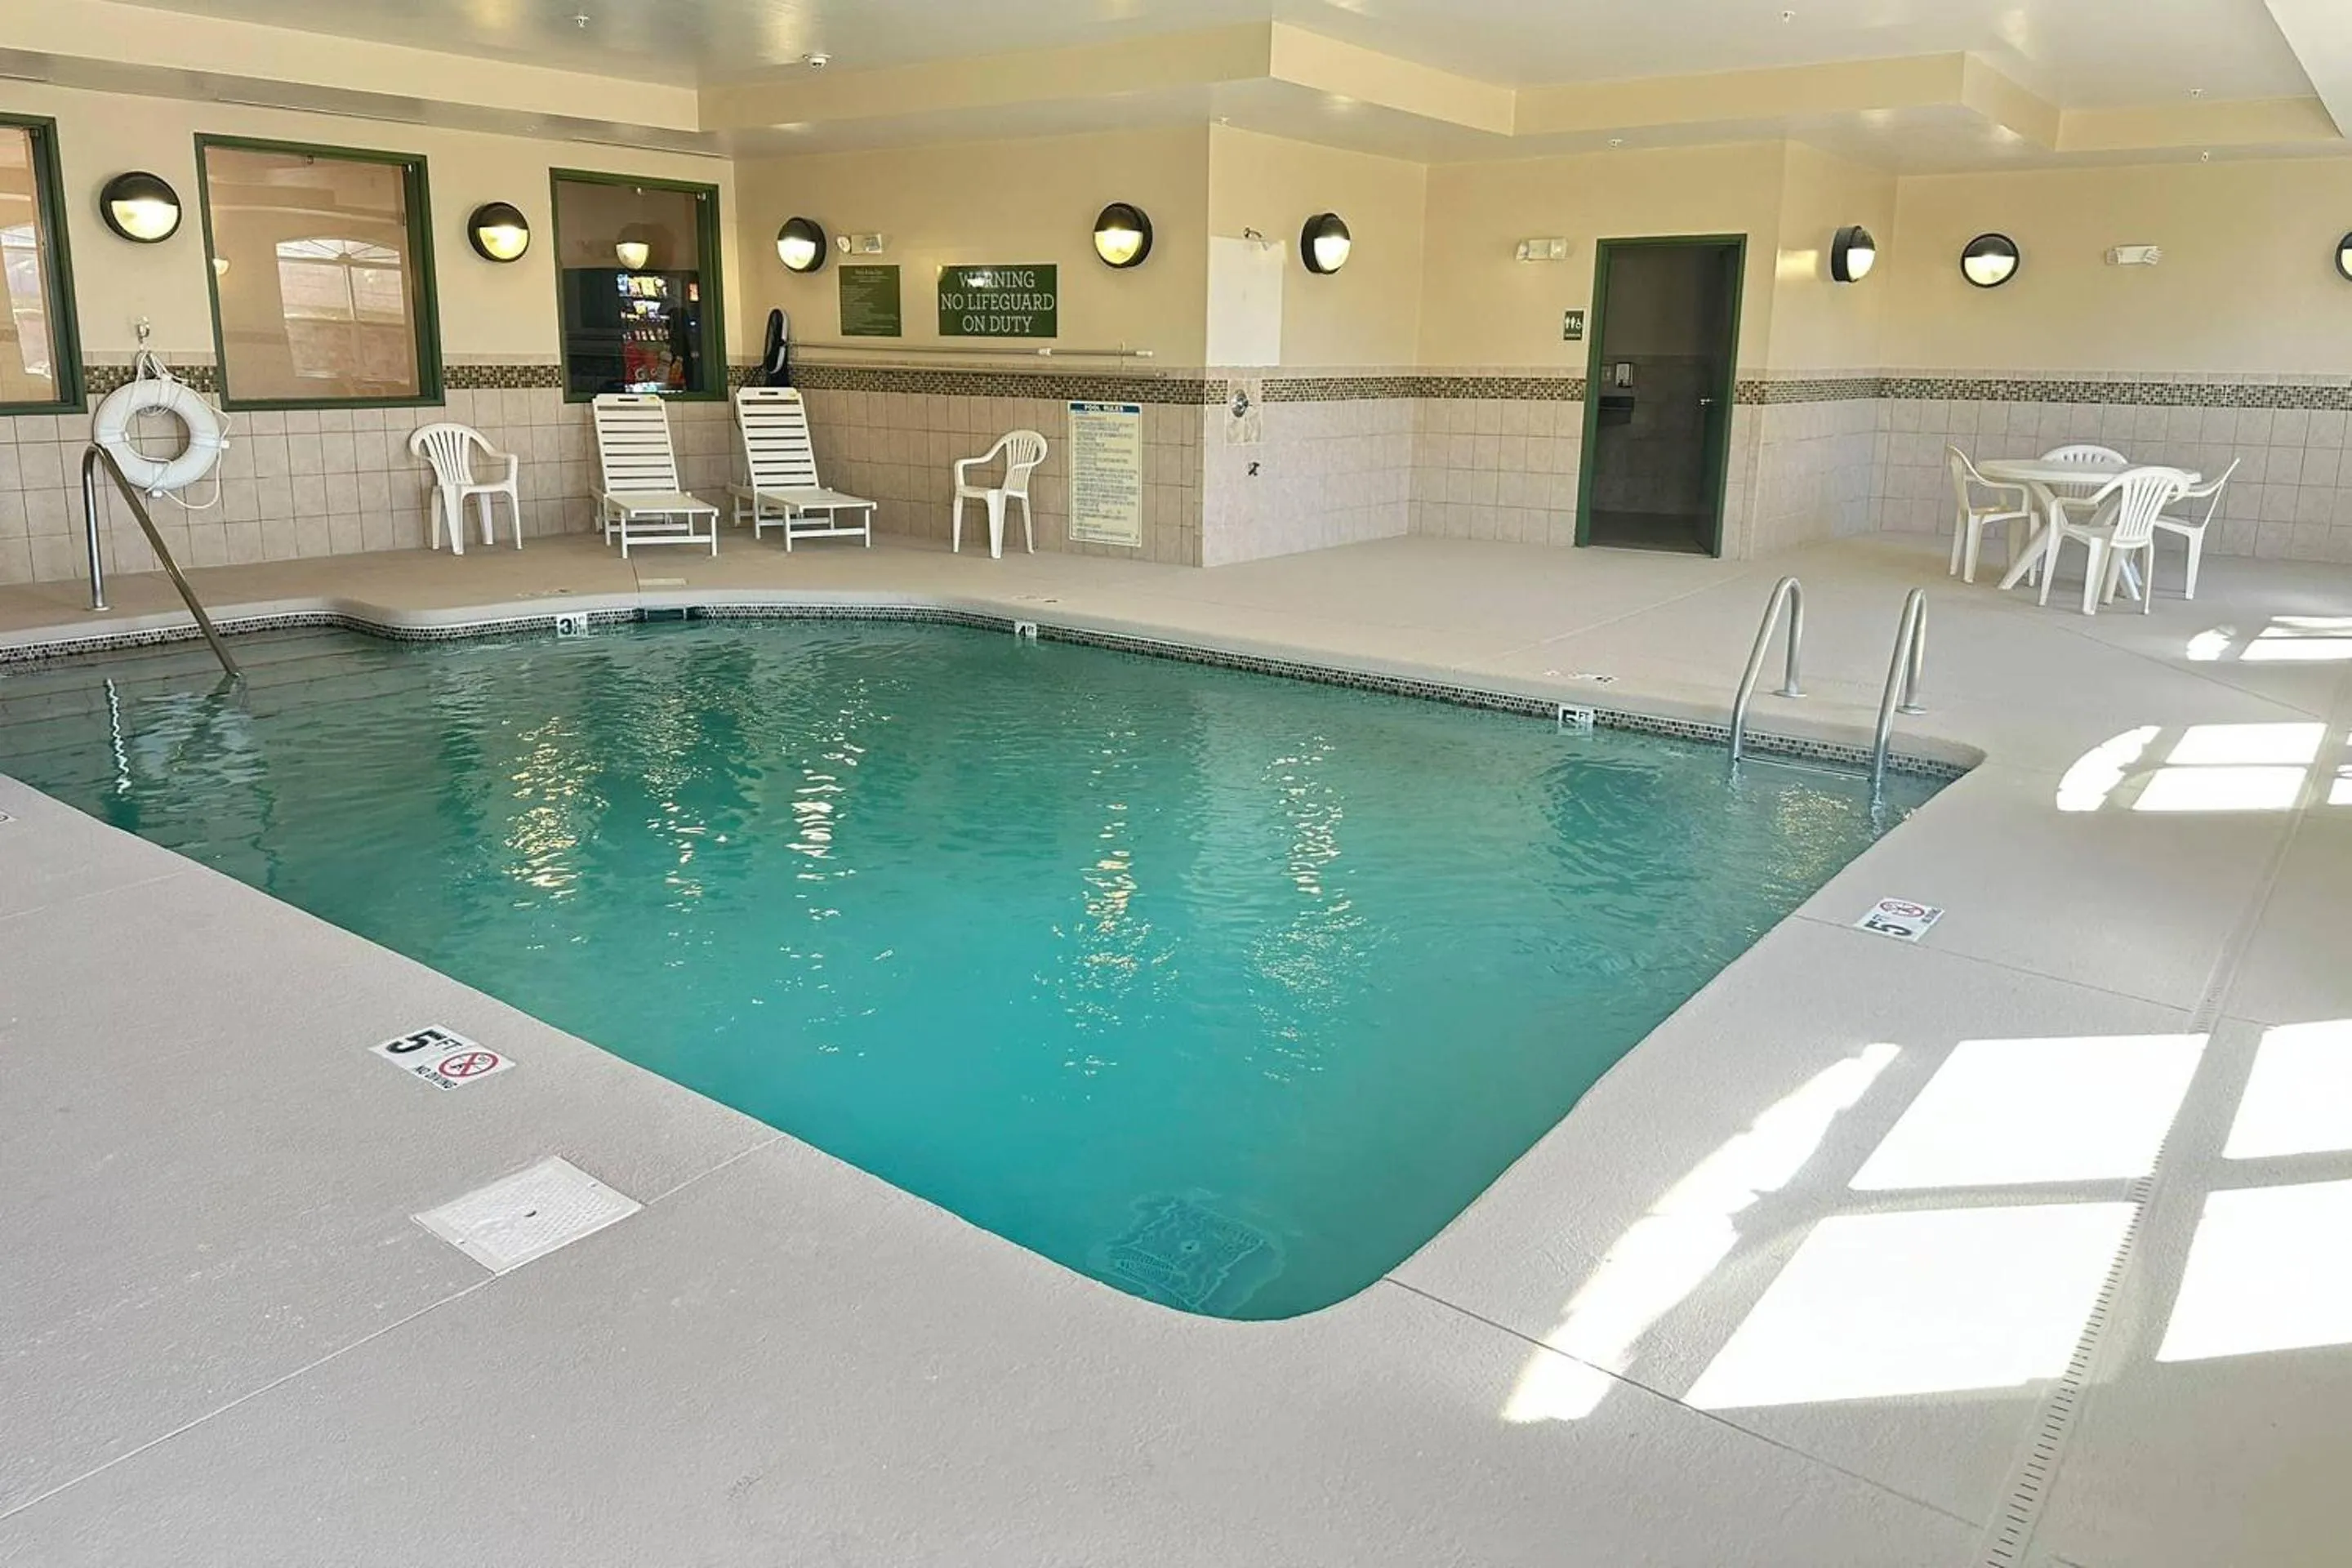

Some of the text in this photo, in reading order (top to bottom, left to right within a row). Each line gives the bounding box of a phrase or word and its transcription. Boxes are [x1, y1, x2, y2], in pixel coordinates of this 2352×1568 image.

[958, 270, 1035, 288] WRNING
[941, 293, 1054, 311] NO LIFEGUARD
[963, 316, 1032, 332] ON DUTY
[559, 618, 572, 635] 3
[1864, 920, 1912, 936] 5
[385, 1029, 463, 1054] 5 FT
